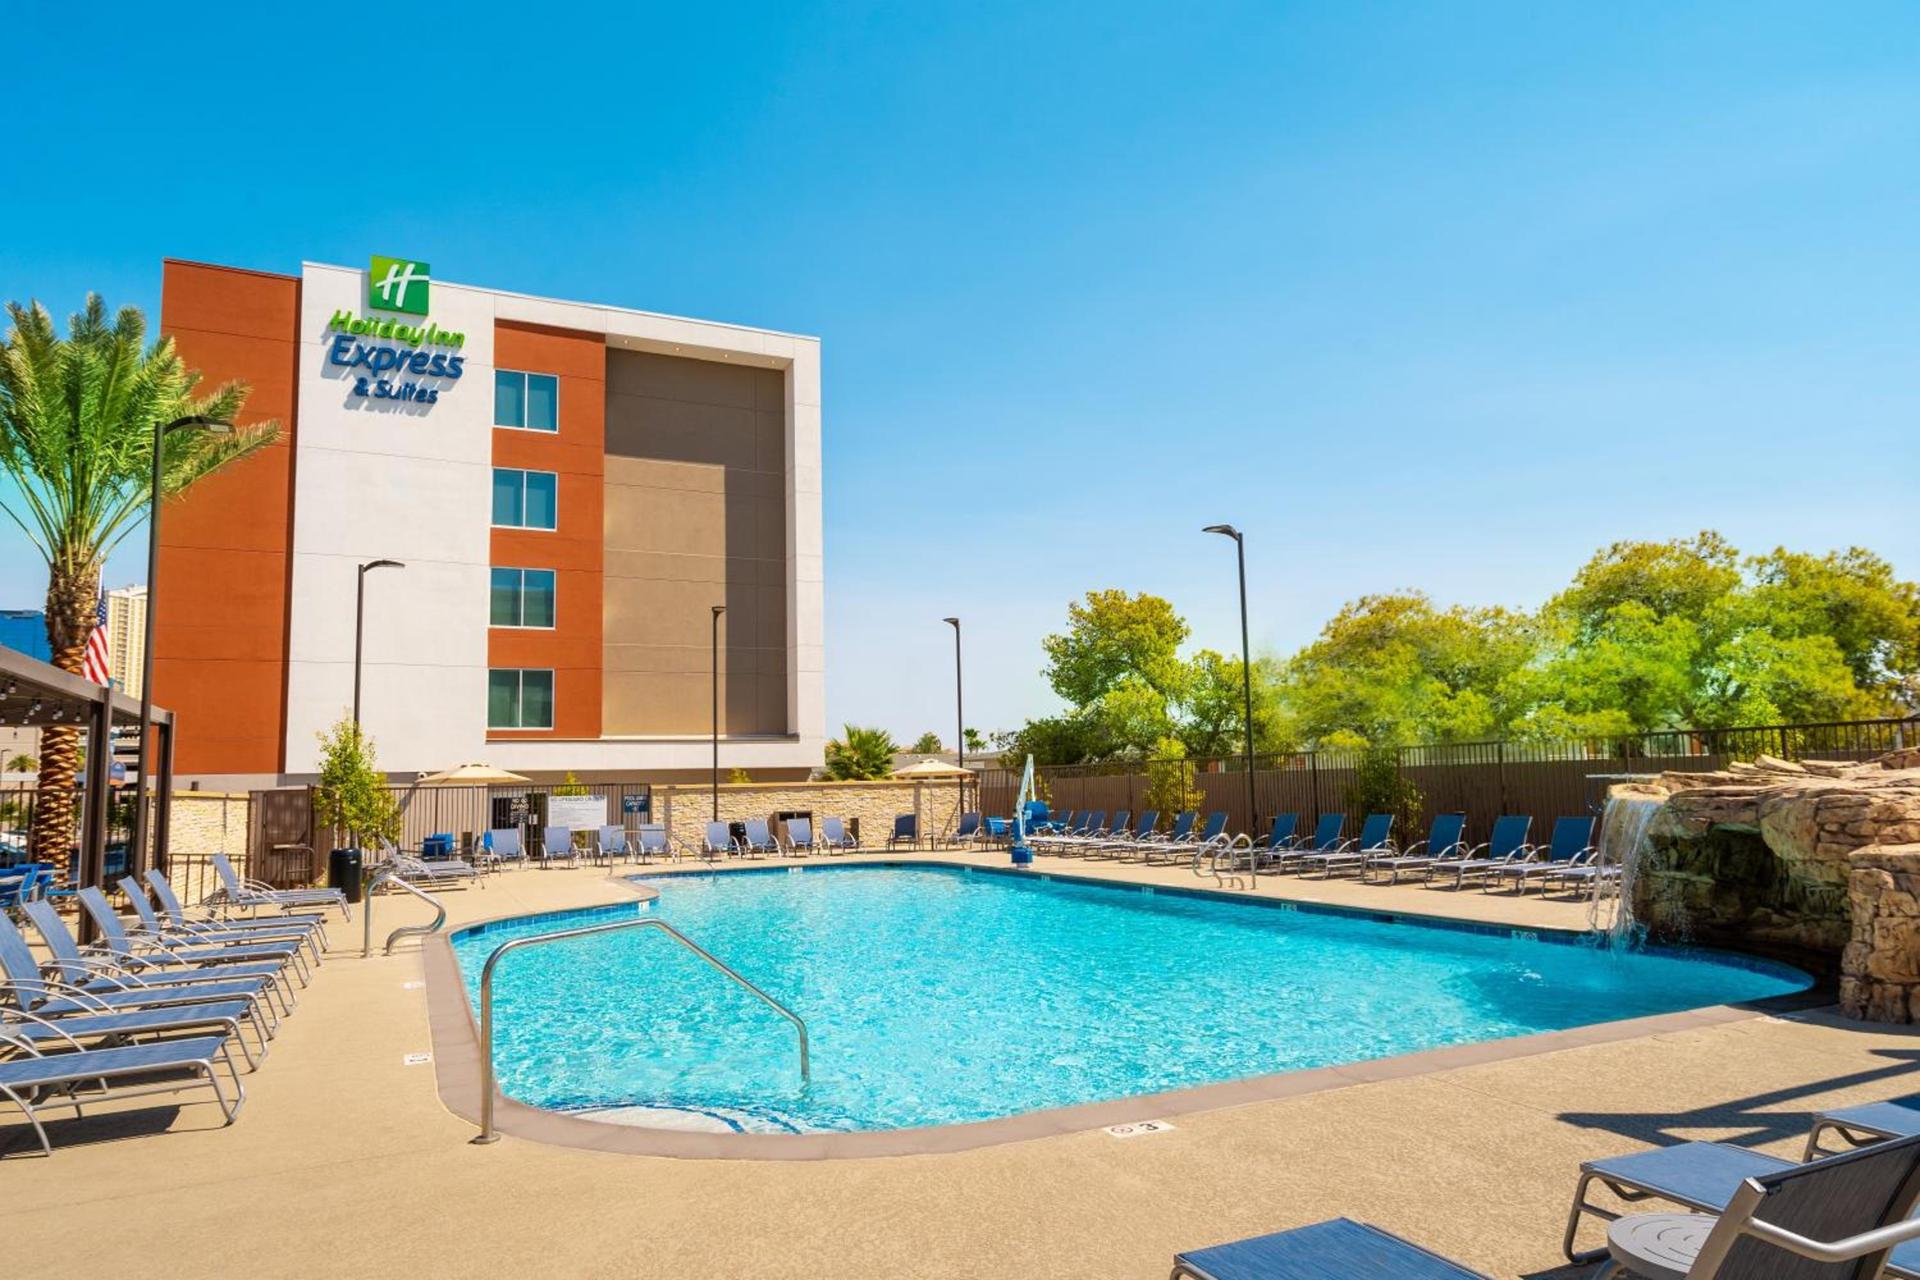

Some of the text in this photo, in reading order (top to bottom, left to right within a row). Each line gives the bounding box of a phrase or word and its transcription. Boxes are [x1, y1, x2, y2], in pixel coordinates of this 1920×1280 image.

[329, 310, 465, 348] Holiday Inn
[330, 334, 465, 379] Express
[354, 377, 439, 404] & Suites
